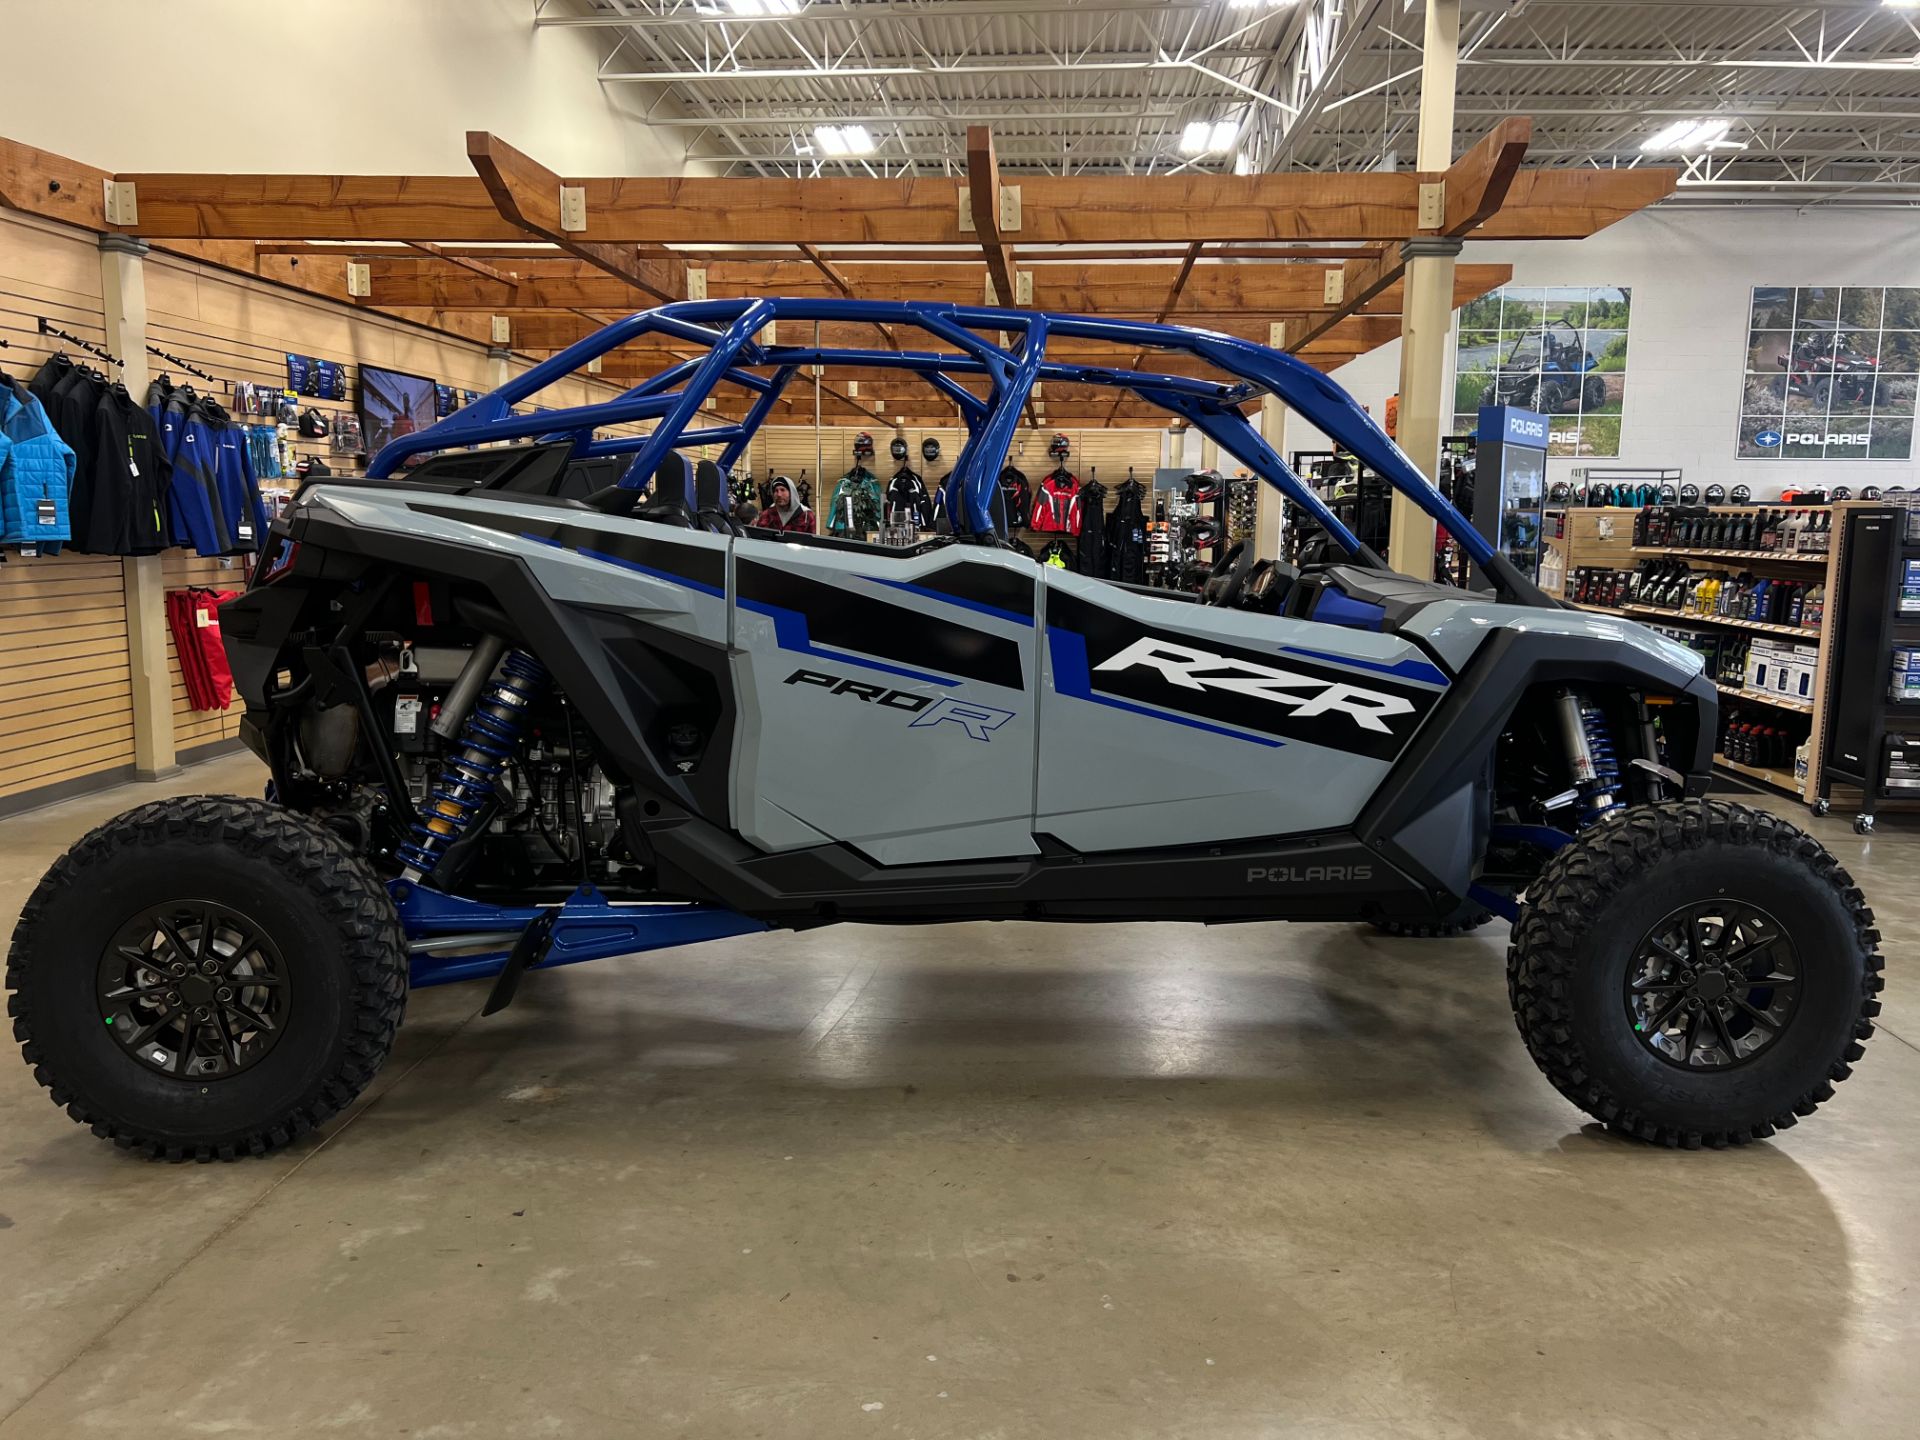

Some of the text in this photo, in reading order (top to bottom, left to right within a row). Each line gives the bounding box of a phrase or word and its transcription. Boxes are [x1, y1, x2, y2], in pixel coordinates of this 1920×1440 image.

[1510, 417, 1543, 438] POLARIS
[1786, 433, 1871, 445] POLARIS
[1092, 636, 1416, 735] RZR
[783, 668, 1017, 742] PRO R
[1247, 865, 1373, 882] POLARIS
